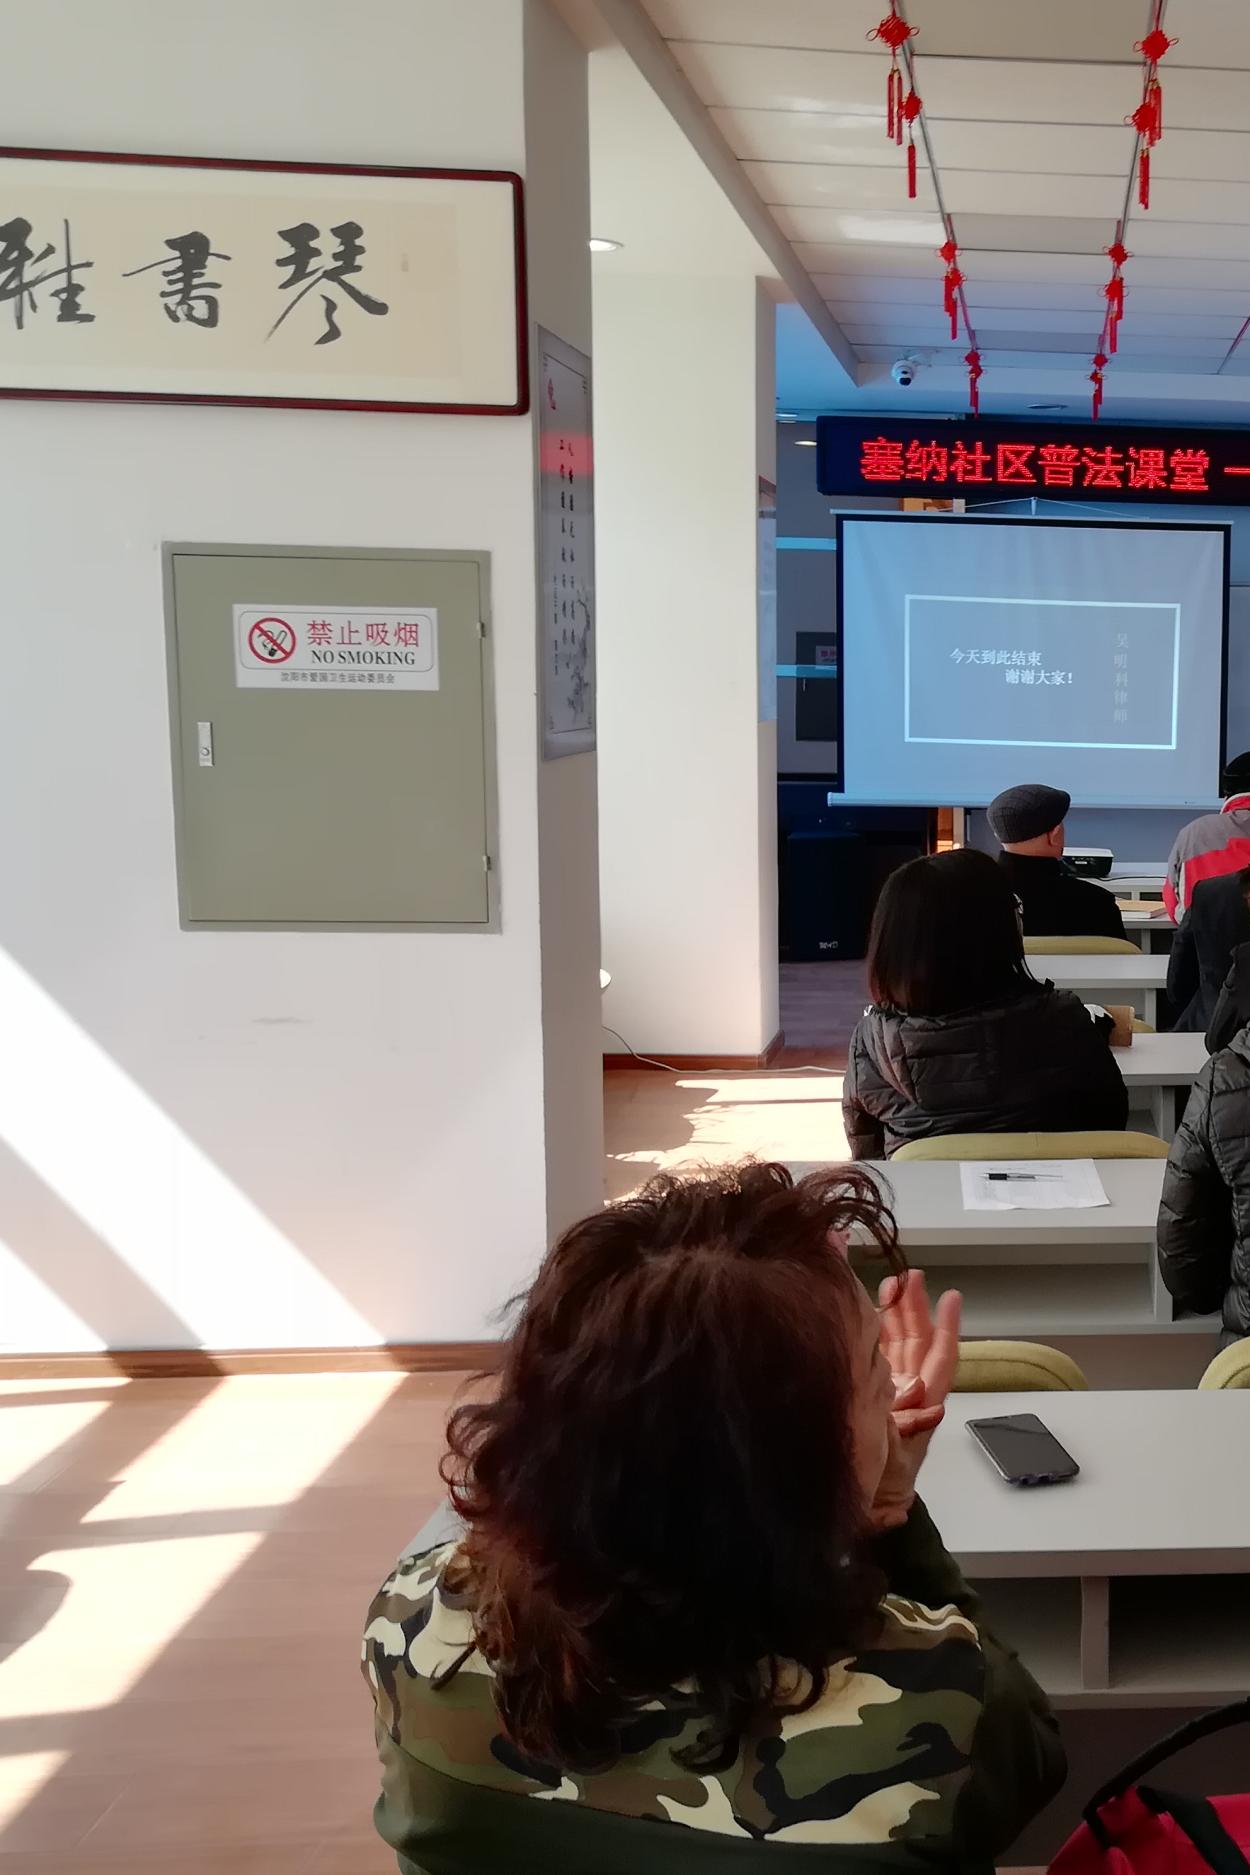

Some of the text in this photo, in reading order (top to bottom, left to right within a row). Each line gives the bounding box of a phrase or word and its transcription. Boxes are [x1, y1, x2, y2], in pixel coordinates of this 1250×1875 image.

[306, 619, 420, 648] 禁止吸烟
[311, 650, 416, 666] NO SMOKING
[949, 647, 1043, 667] 今天到此结束
[280, 671, 396, 684] 沈阳市爱国卫生运动委员会
